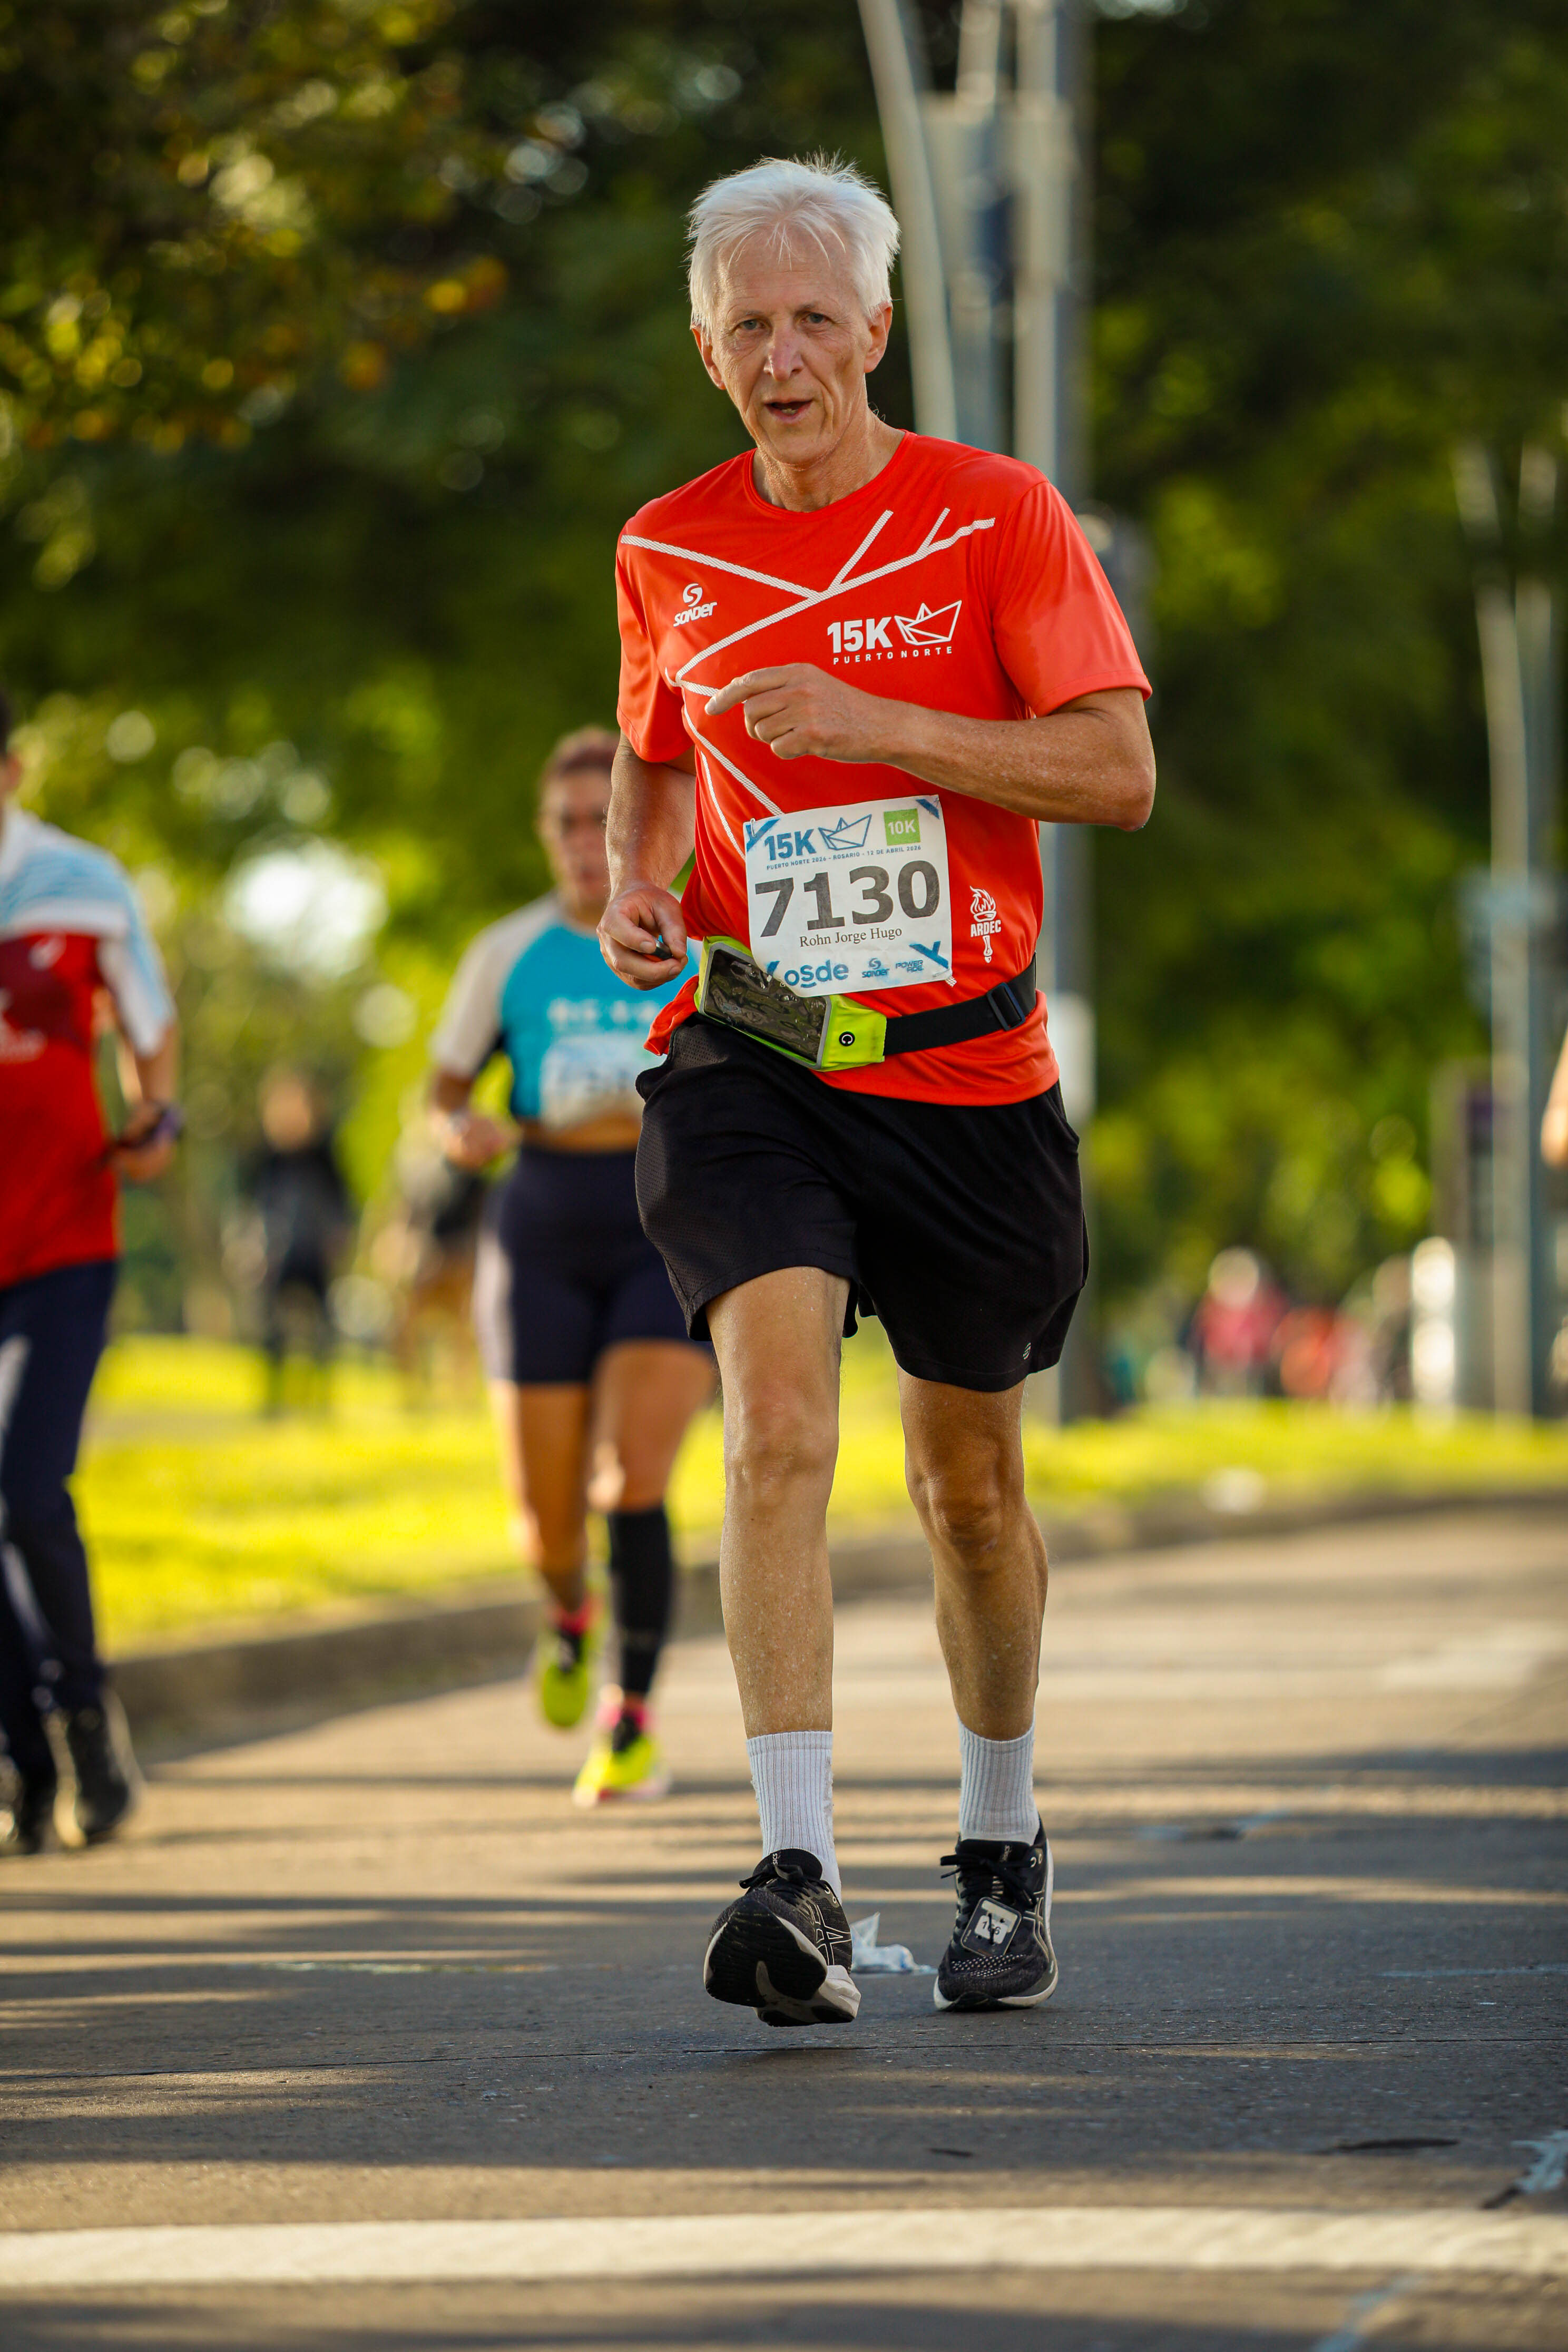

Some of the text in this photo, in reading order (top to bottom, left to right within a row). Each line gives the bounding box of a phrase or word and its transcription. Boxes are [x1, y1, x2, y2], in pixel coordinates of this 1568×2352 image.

[827, 616, 893, 653] 15K
[833, 646, 952, 665] PUERTO NORTE
[888, 819, 916, 835] 10K
[764, 829, 817, 861] 15K
[754, 860, 940, 938] 7130
[799, 927, 903, 947] Rohn Jorge Hugo
[971, 920, 1002, 937] ARDEC
[784, 959, 849, 988] osde
[895, 959, 924, 968] POWER
